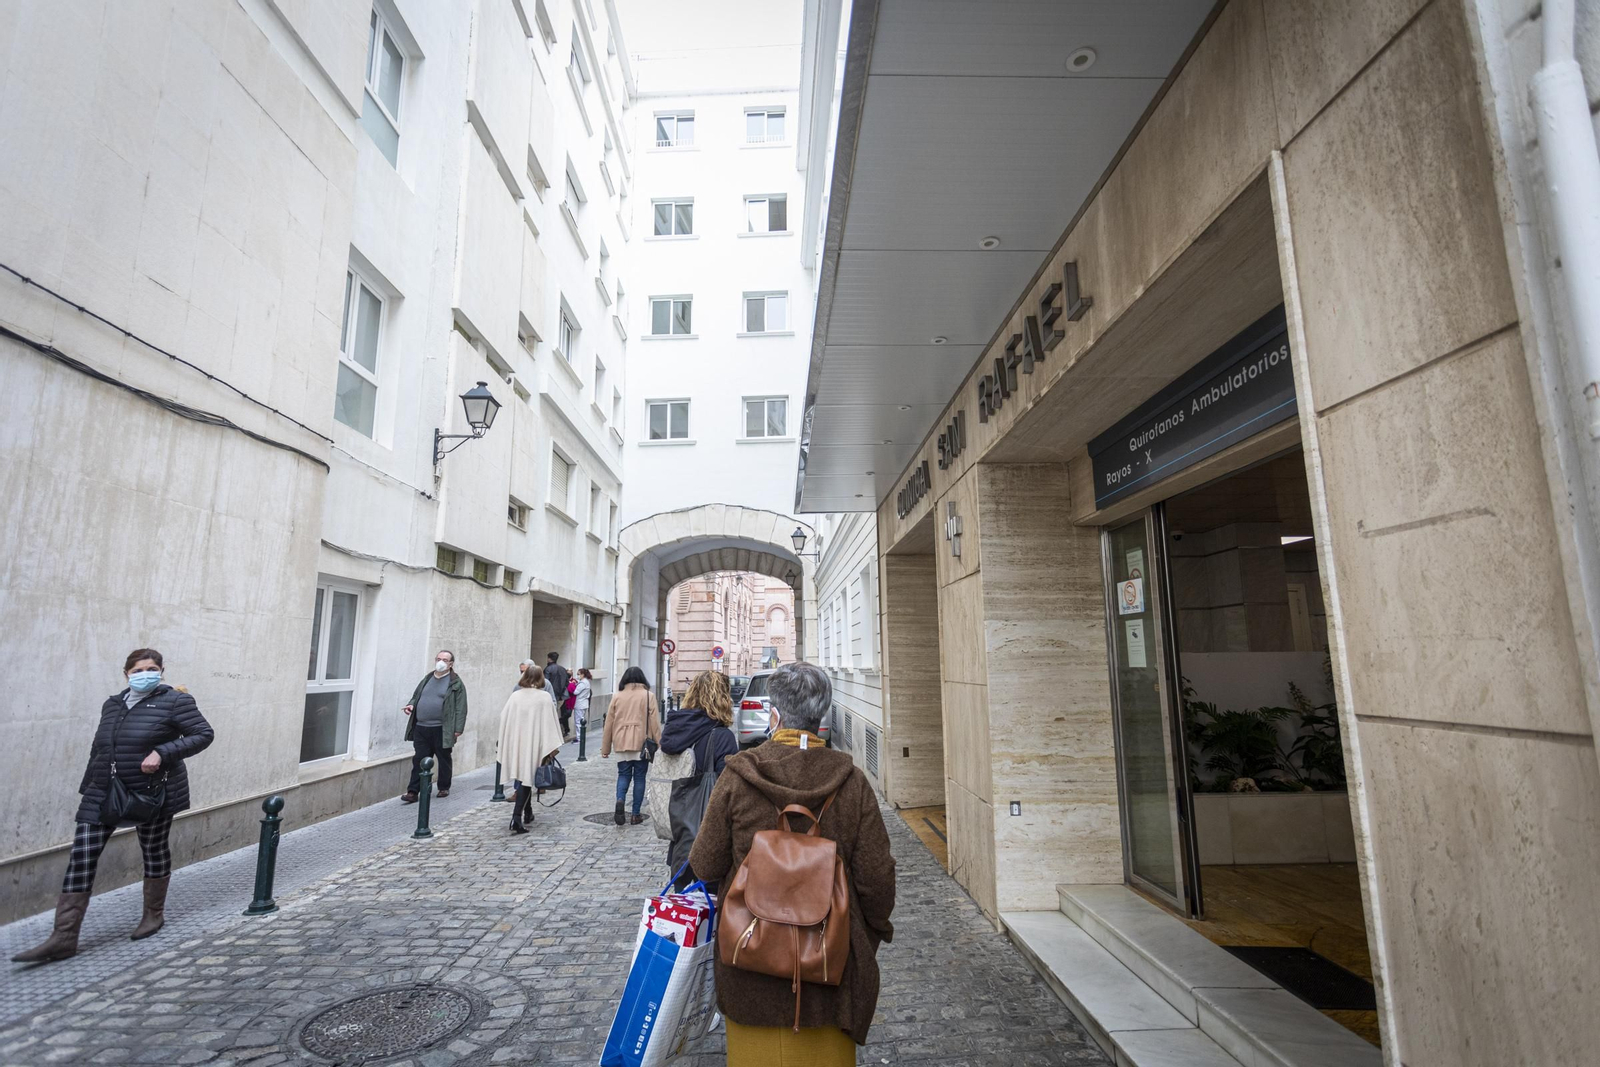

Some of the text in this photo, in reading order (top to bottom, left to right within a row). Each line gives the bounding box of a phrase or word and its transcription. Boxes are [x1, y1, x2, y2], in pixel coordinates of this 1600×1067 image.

[938, 410, 966, 470] SAN
[978, 262, 1093, 423] RAFAEL
[1129, 344, 1288, 452] Quirofanos Ambulatorios
[1106, 464, 1132, 486] Rayos
[1145, 448, 1153, 465] X
